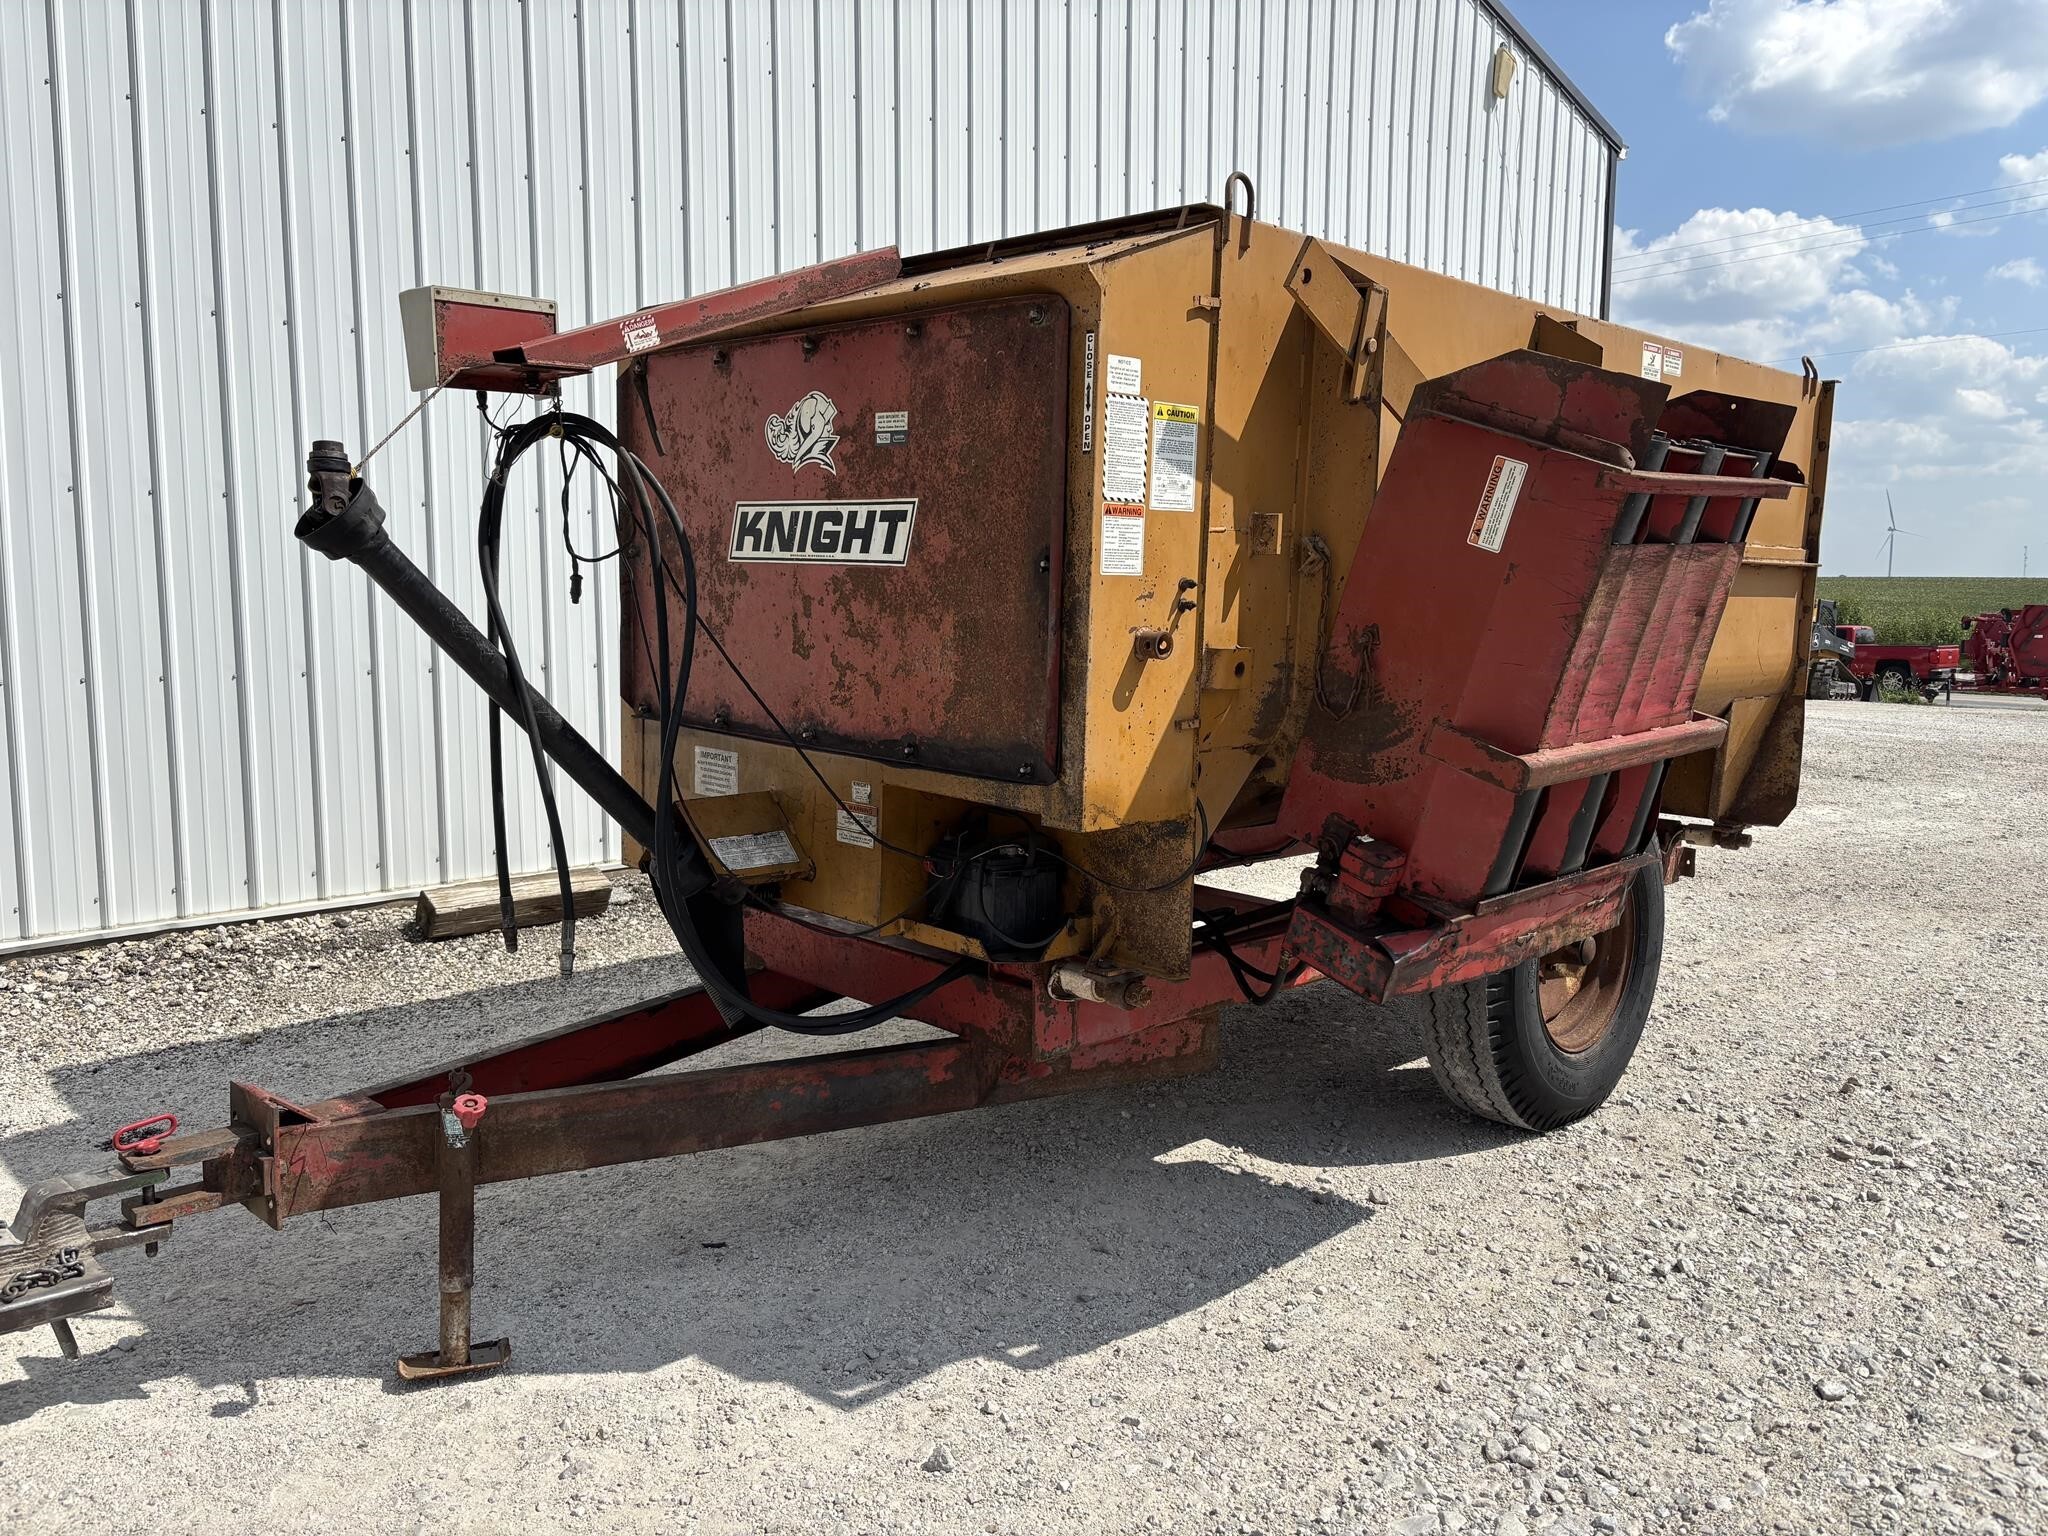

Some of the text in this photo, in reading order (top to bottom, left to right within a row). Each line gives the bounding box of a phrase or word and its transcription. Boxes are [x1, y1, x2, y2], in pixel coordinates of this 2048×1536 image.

[1086, 334, 1094, 379] CLOSE
[1166, 408, 1196, 420] CAUTION
[1083, 415, 1091, 449] OPEN
[1477, 465, 1502, 521] WARNING
[1112, 506, 1142, 516] WARNING
[735, 509, 909, 555] KNIGHT
[700, 751, 732, 763] IMPORTANT
